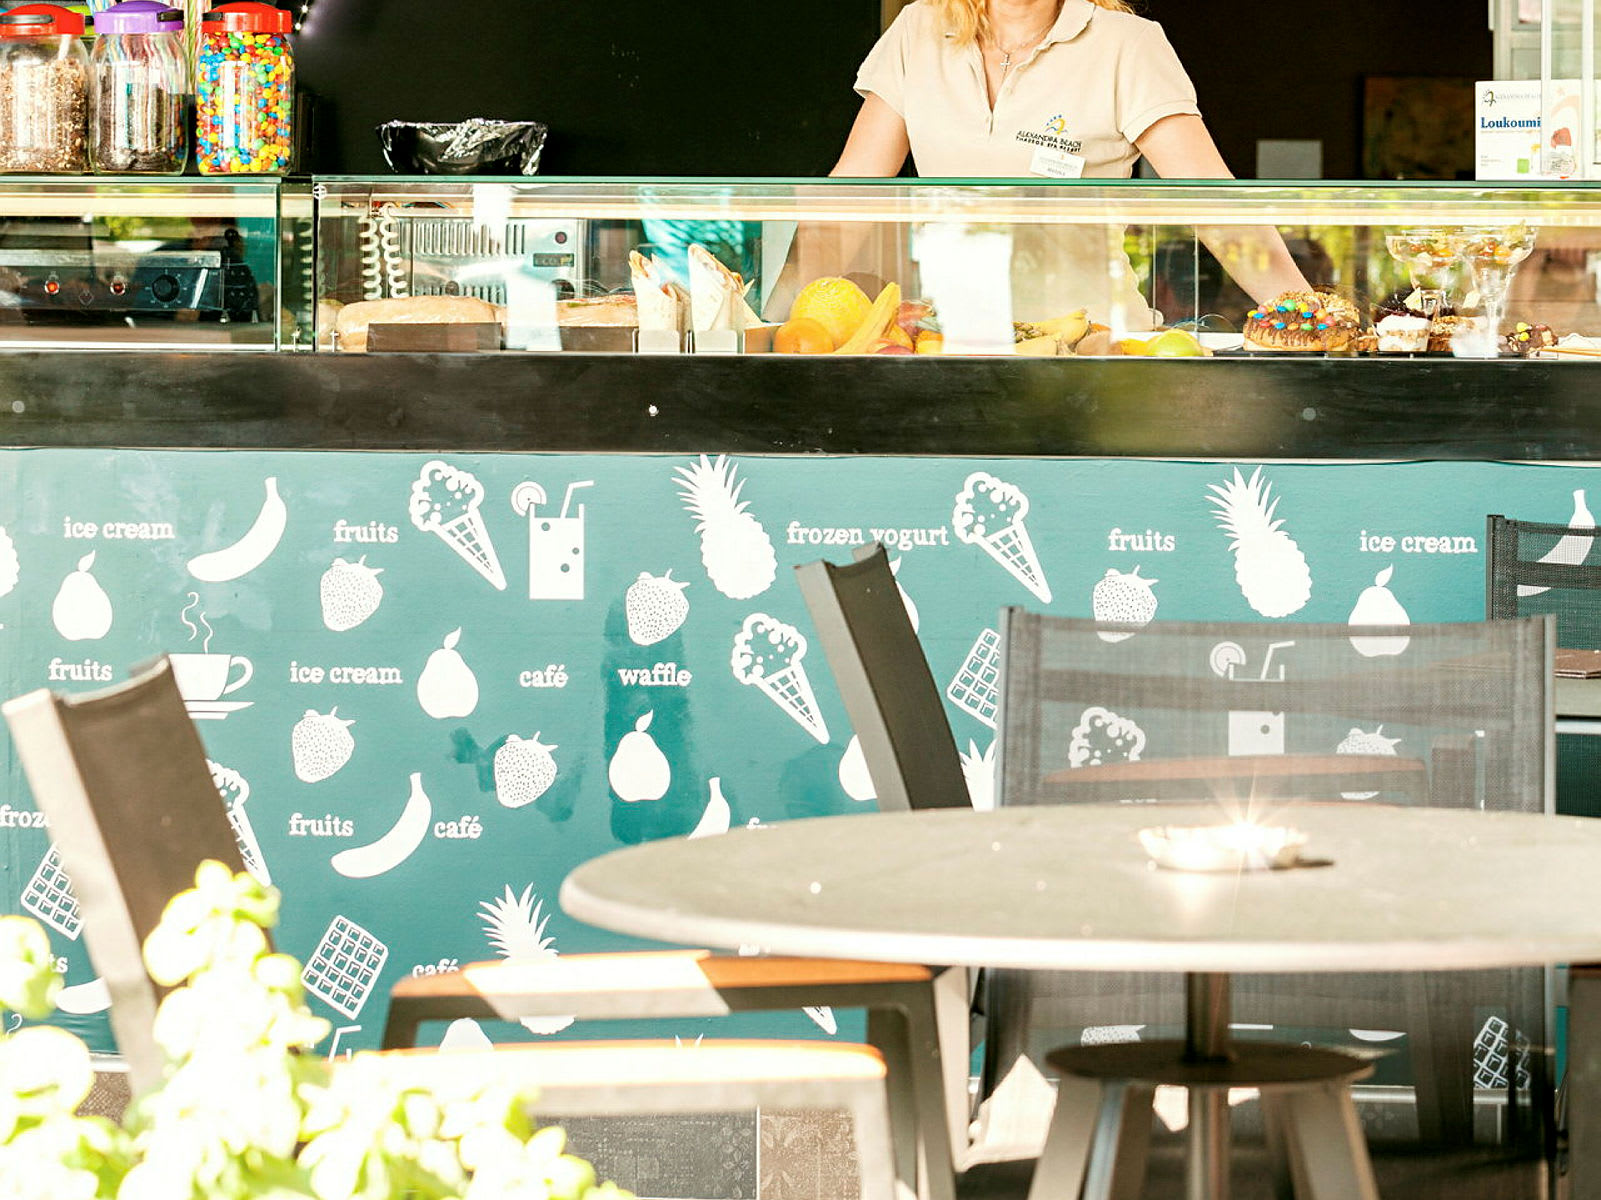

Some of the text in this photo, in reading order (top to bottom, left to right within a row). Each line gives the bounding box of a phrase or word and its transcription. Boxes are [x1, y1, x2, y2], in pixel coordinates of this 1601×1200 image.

[1480, 116, 1541, 129] Loukoumi
[63, 515, 177, 541] ice cream
[332, 518, 399, 544] fruits
[786, 520, 950, 551] frozen yogurt
[1107, 527, 1176, 552] fruits
[1359, 529, 1478, 554] ice cream
[47, 657, 113, 682] fruits
[289, 660, 404, 685] ice cream
[519, 663, 569, 689] café
[617, 661, 693, 687] waffle
[0, 803, 49, 828] froz
[288, 812, 354, 837] fruits
[433, 814, 484, 840] café
